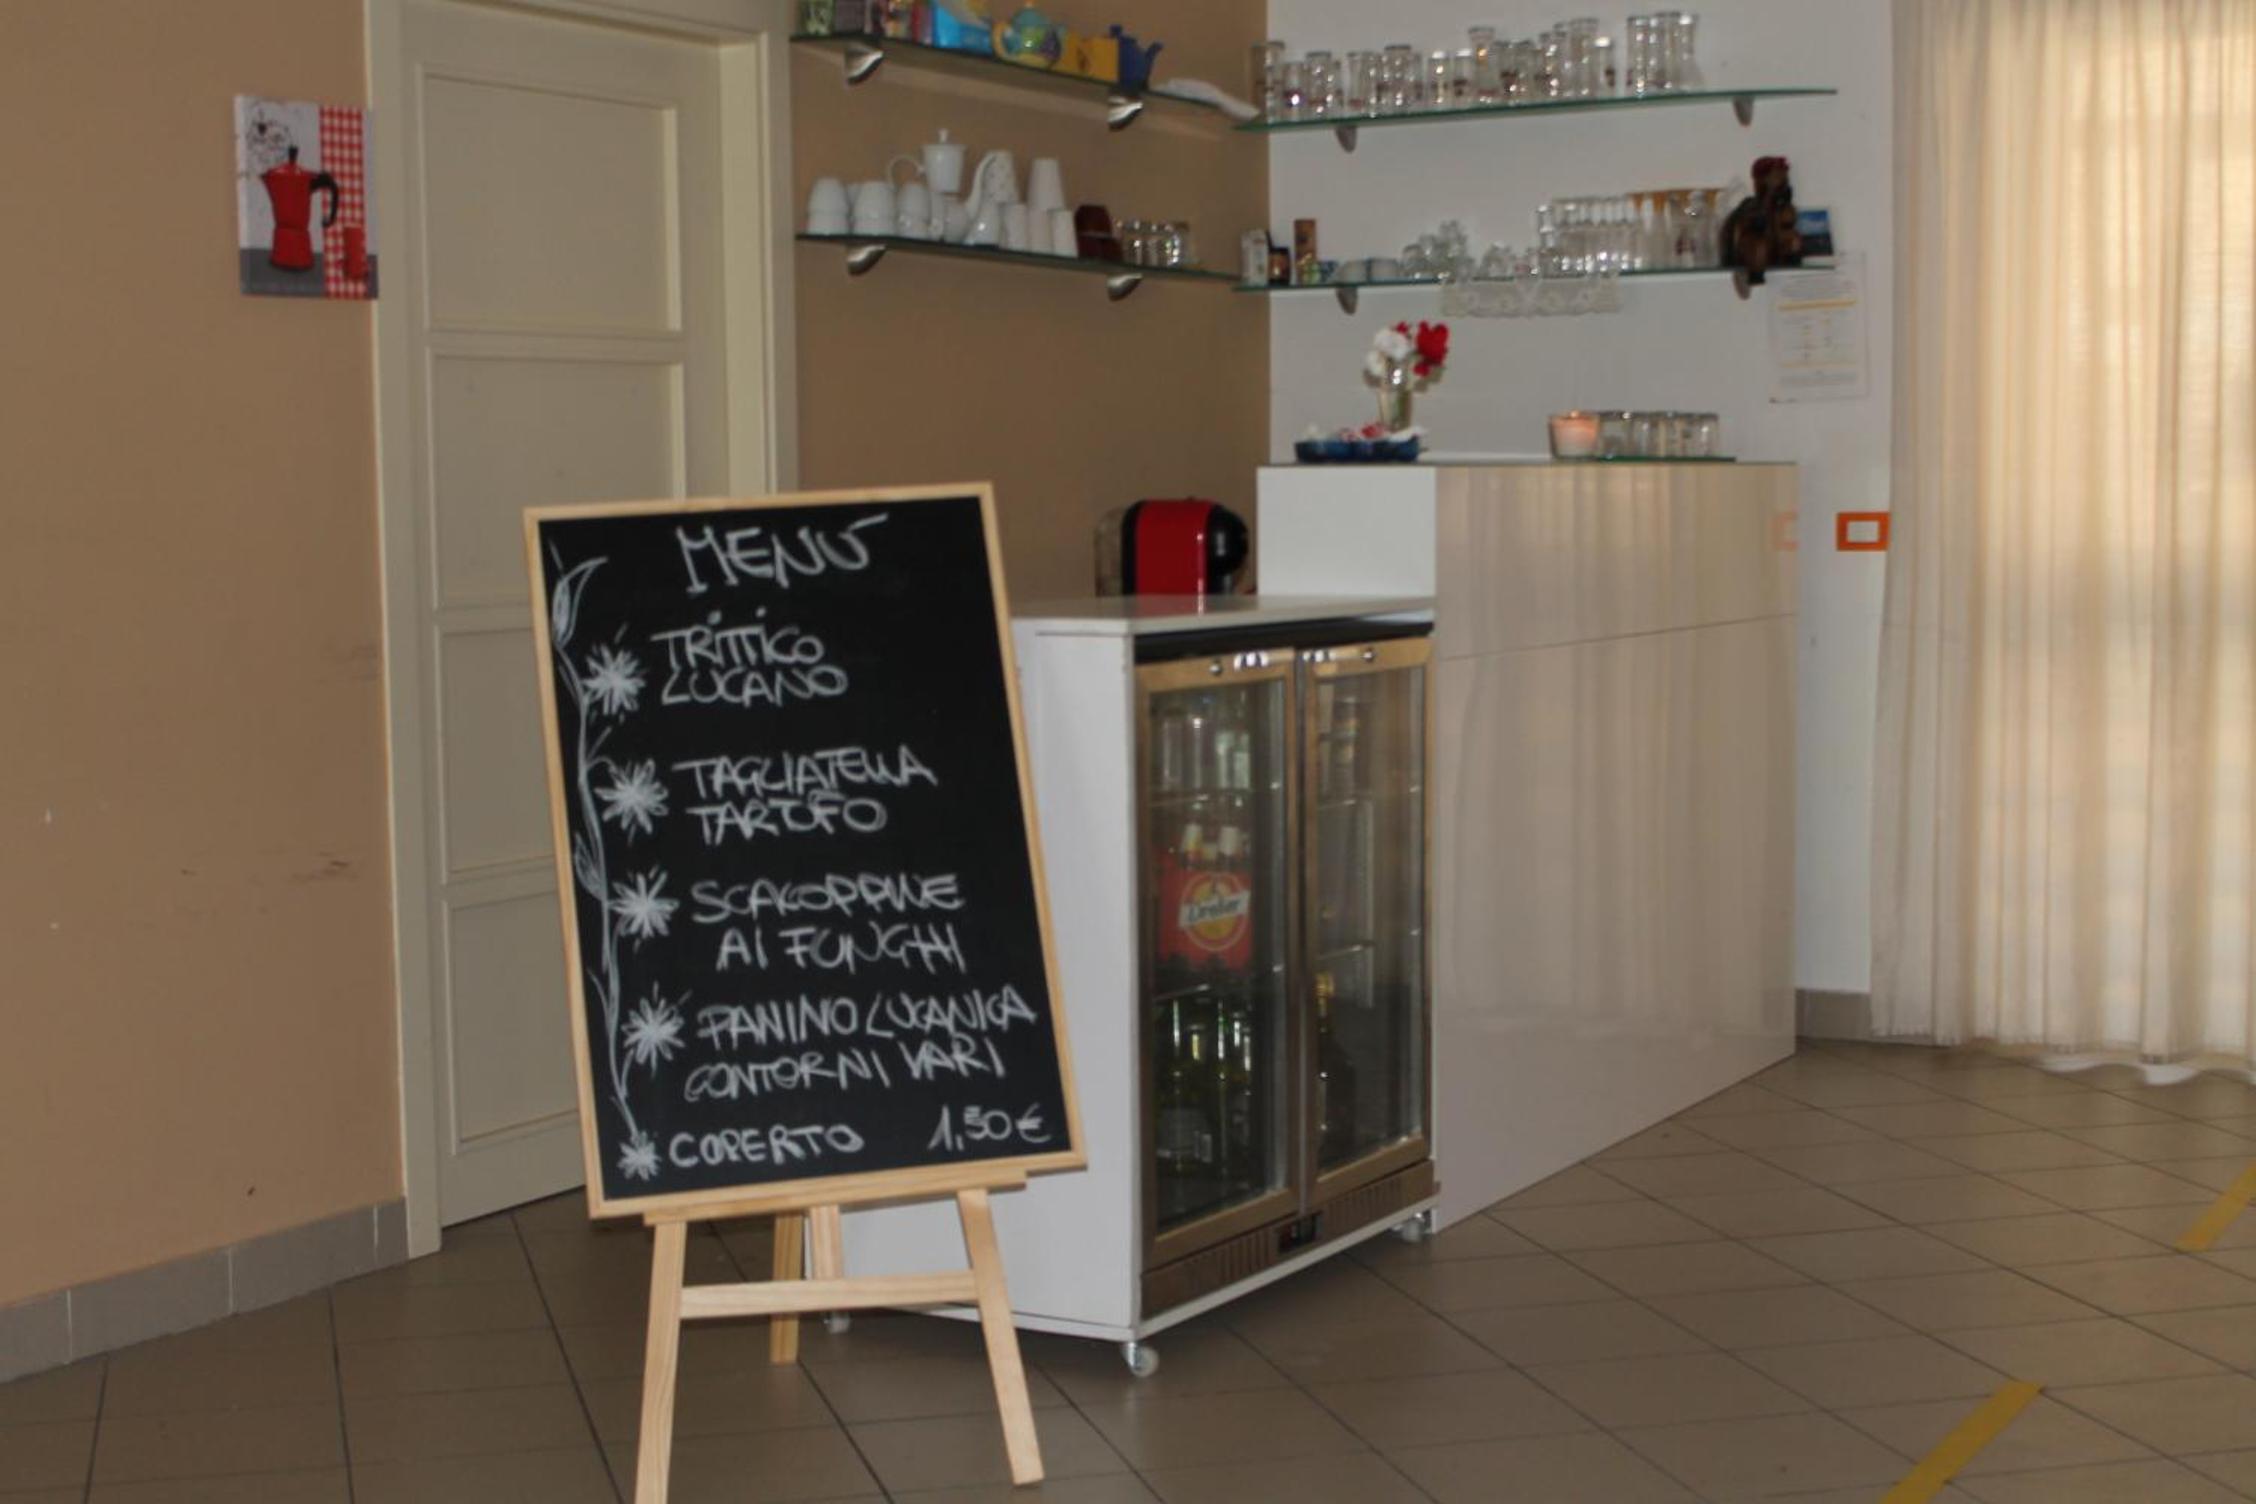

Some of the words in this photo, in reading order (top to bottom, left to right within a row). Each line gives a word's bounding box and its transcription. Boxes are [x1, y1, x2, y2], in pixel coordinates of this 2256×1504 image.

[651, 606, 824, 669] TRITTICO
[662, 665, 848, 707] LUCANO
[671, 745, 938, 800] TAGLIATELLA
[715, 926, 769, 971] AI
[777, 921, 967, 975] FUNGHI
[696, 994, 858, 1050] PANINO
[866, 984, 1038, 1037] LUCANICA
[684, 1048, 892, 1101] CONTORNI
[898, 1032, 1005, 1081] VARI
[669, 1124, 865, 1168] COPERTO
